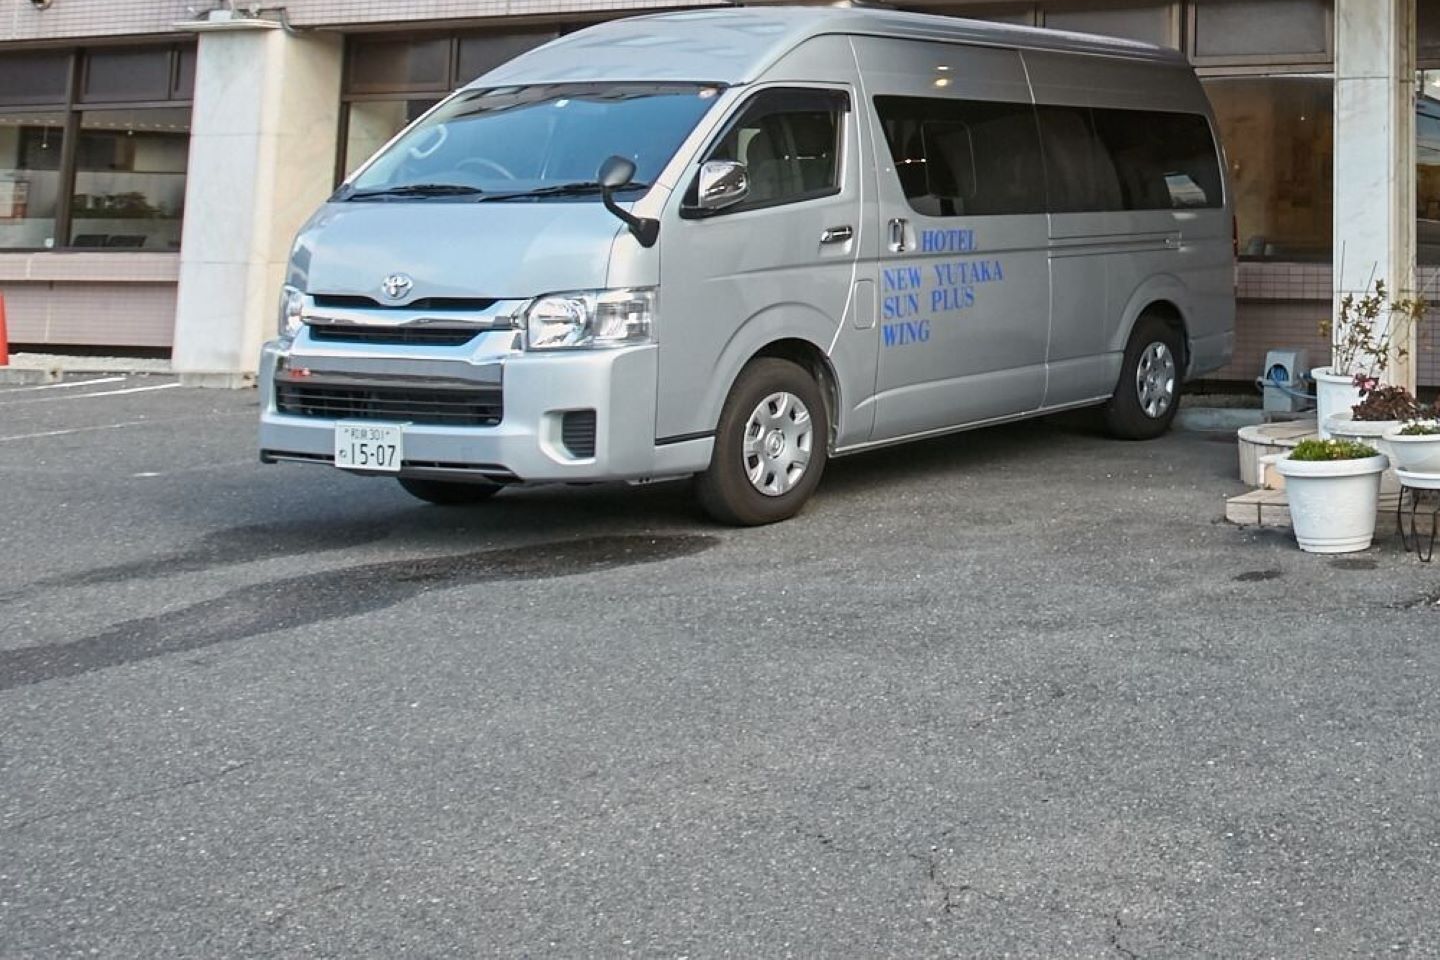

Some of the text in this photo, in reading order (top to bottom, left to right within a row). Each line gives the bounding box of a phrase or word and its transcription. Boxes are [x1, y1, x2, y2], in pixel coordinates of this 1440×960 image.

[921, 229, 977, 252] HOTEL
[883, 260, 1004, 291] NEW YUTAKA
[883, 286, 975, 320] SUN PLUS
[883, 319, 930, 348] WING
[351, 443, 396, 467] 15-07
